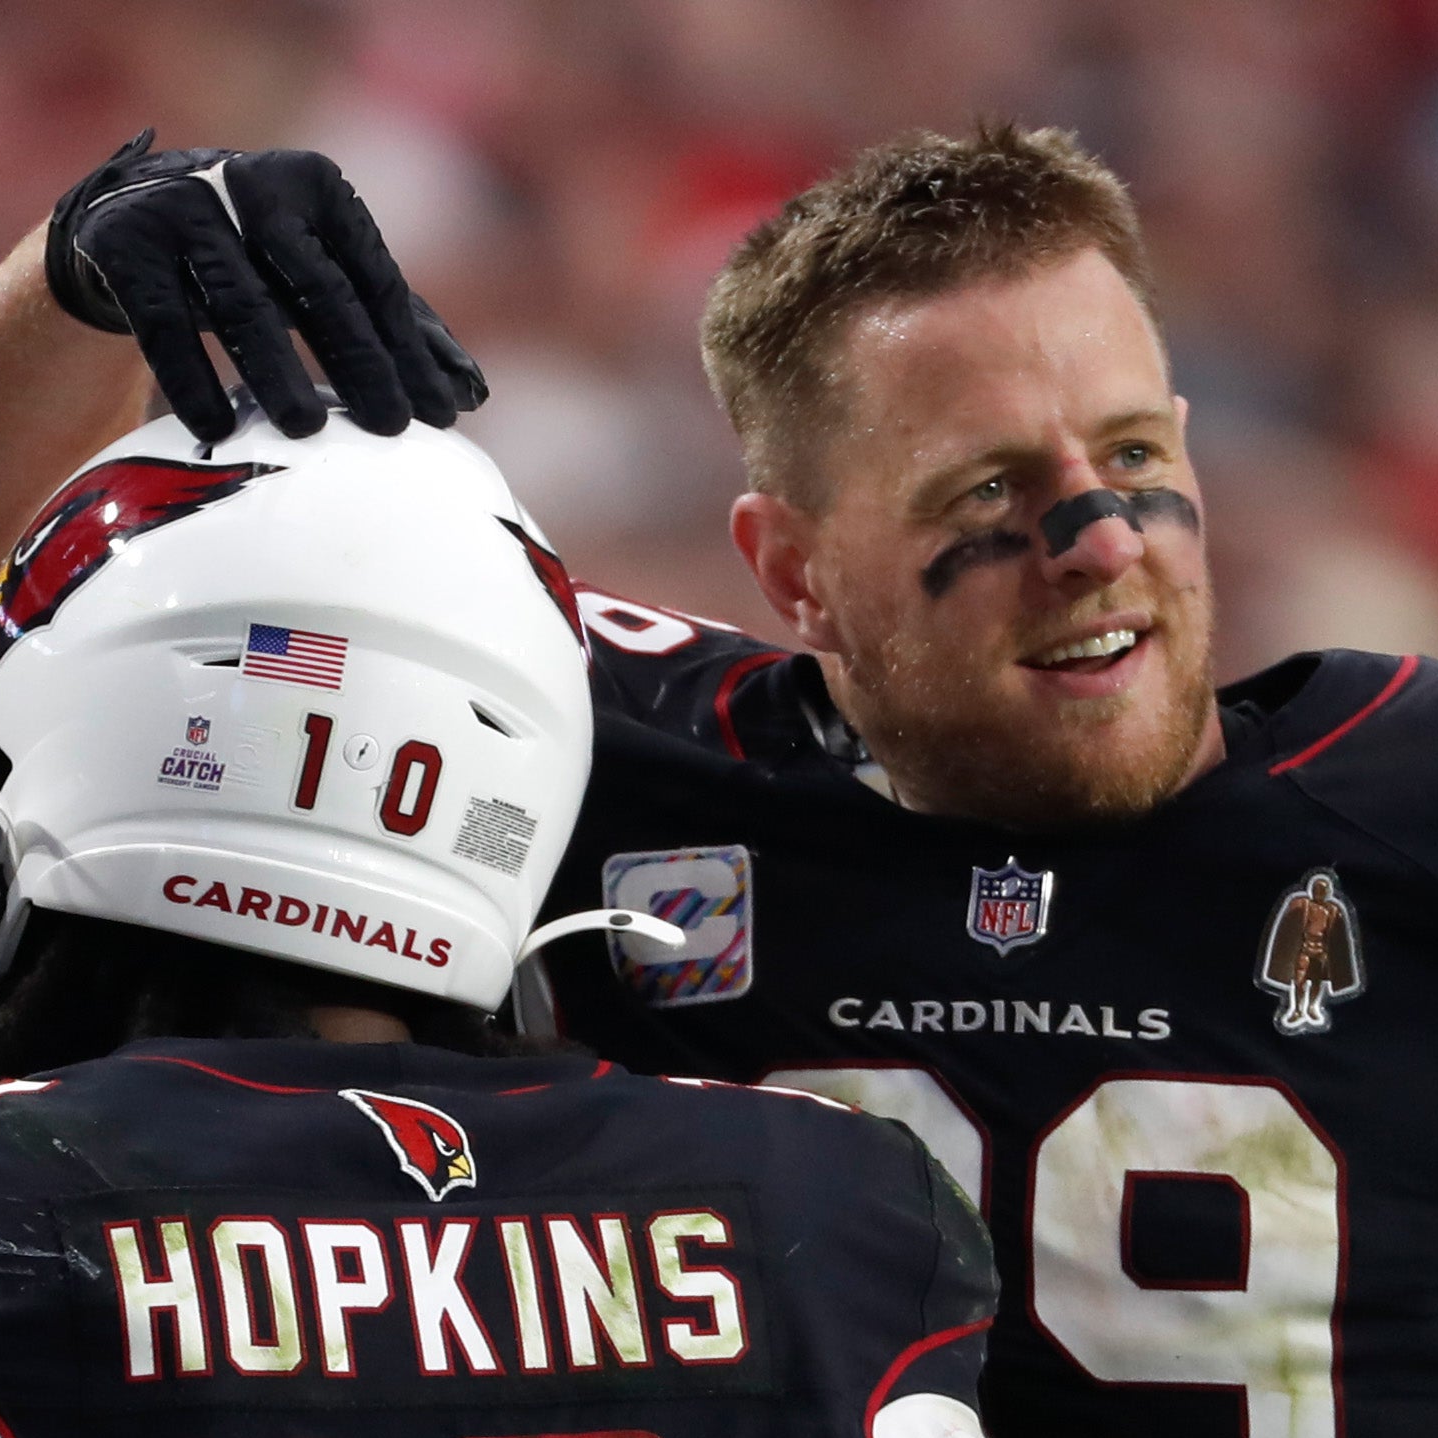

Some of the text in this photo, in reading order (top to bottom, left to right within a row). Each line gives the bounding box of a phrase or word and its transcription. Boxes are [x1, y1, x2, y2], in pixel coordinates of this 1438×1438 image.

[161, 757, 225, 783] CATCH
[173, 747, 217, 762] CRUCIAL
[162, 874, 453, 968] CARDINALS
[979, 899, 1033, 936] NFL
[827, 997, 1172, 1041] CARDINALS
[103, 1207, 746, 1384] HOPKINS
